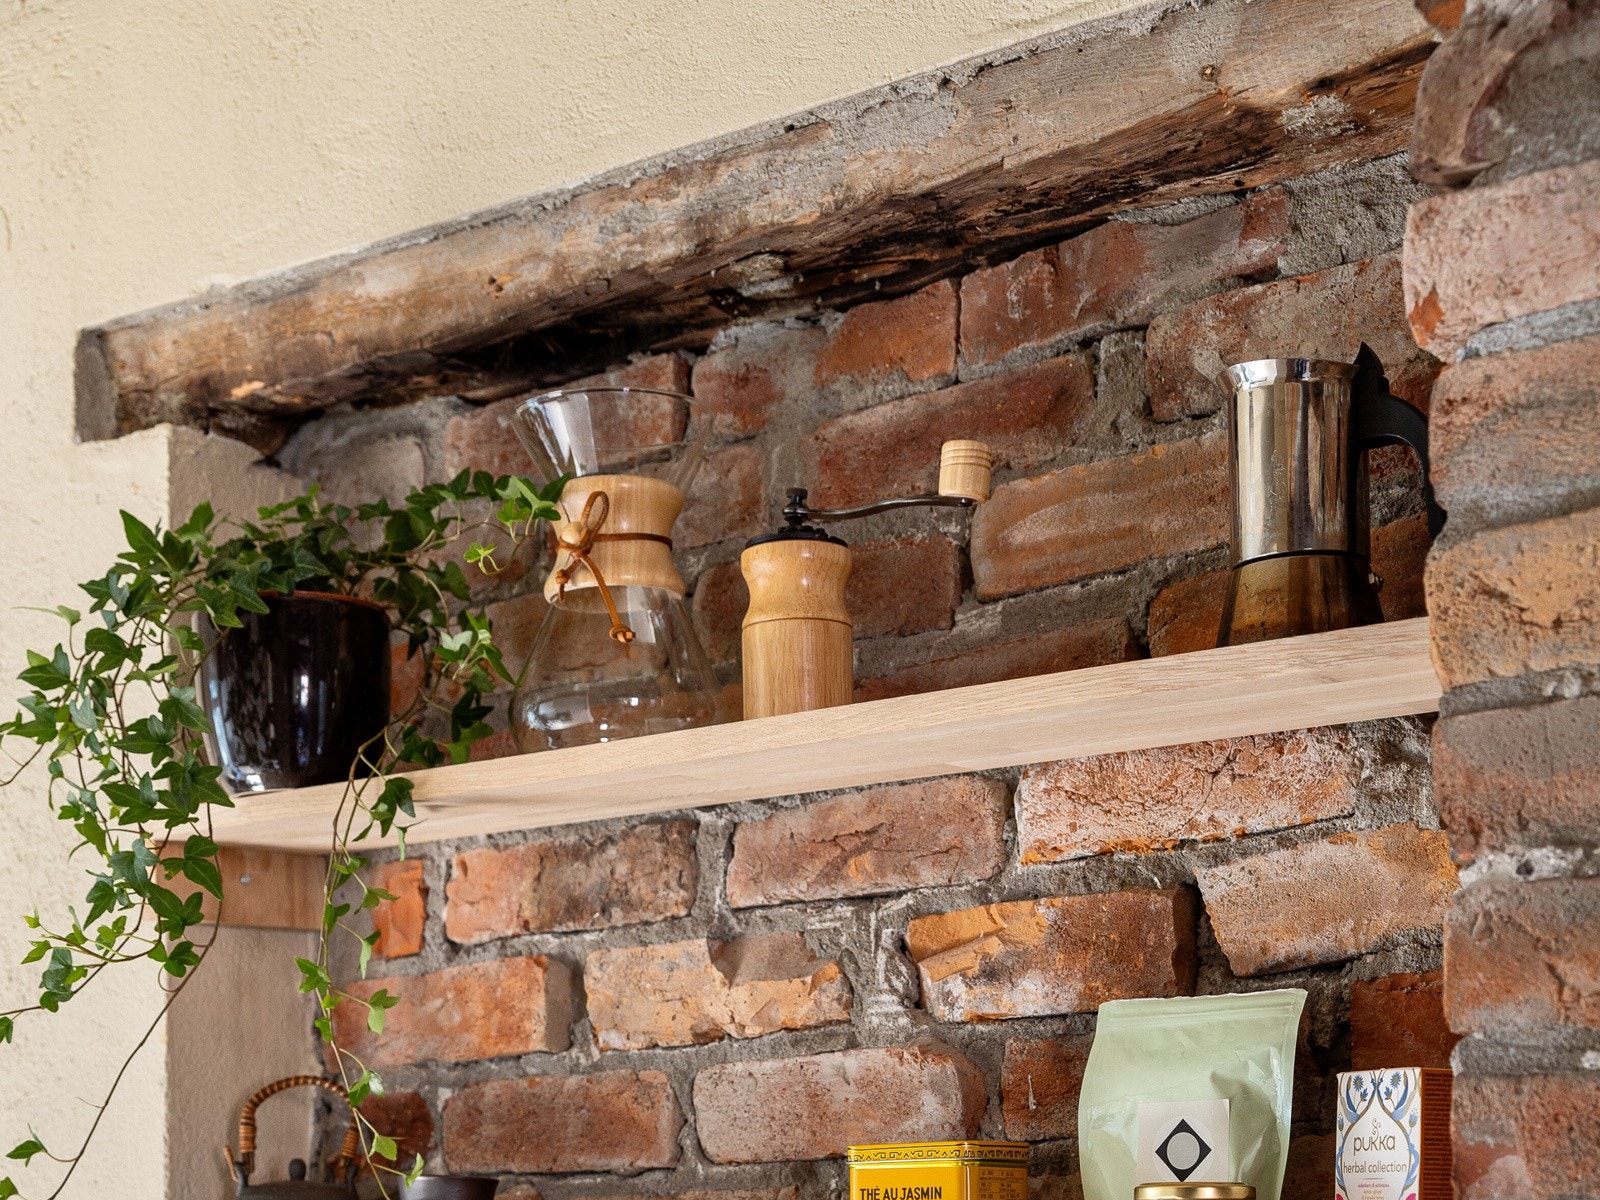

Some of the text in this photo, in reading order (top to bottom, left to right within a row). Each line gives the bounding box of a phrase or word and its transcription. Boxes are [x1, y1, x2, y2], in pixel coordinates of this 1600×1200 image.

[1354, 1134, 1396, 1156] pukka
[1343, 1160, 1407, 1174] herbal collection
[859, 1185, 942, 1200] THÉ AU JASMIN
